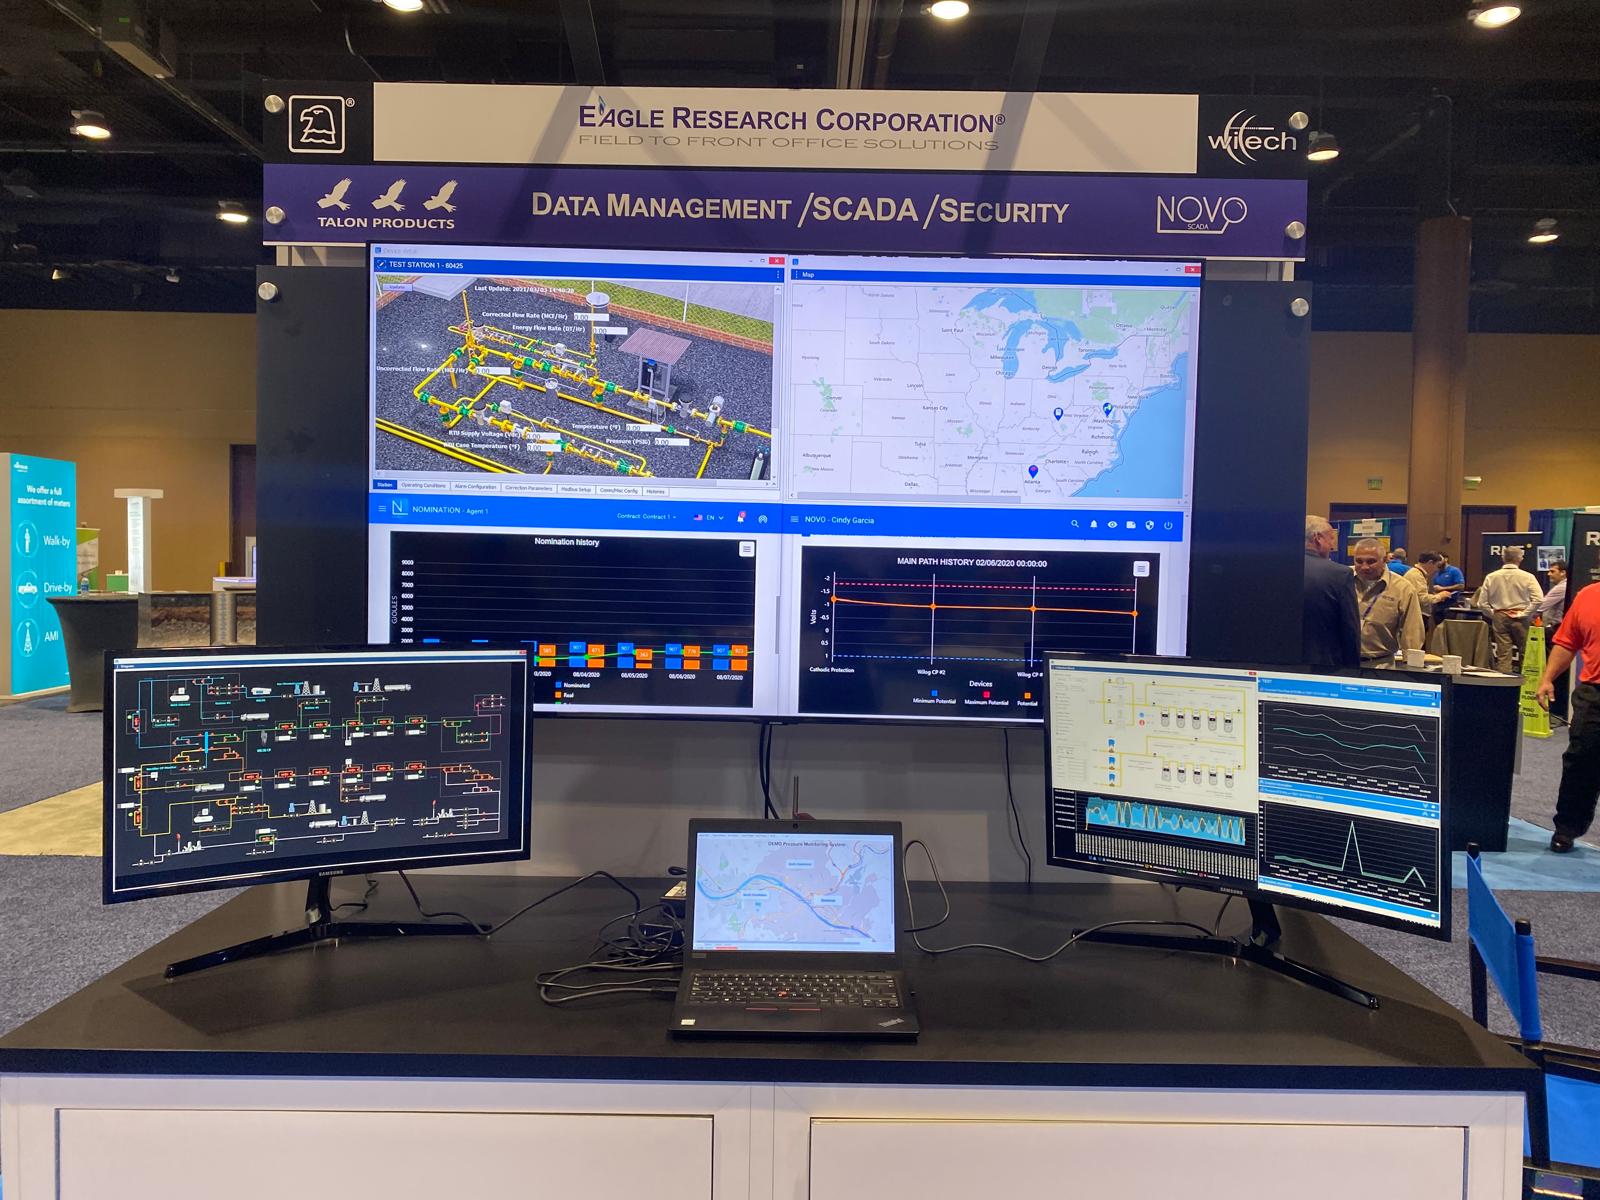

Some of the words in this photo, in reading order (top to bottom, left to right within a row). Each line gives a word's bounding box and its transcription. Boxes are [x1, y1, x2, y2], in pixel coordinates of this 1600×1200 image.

[579, 100, 664, 129] EAGLE
[672, 106, 807, 132] RESEARCH
[579, 134, 643, 146] FIELD
[648, 135, 682, 147] TO
[687, 136, 767, 148] FRONT
[772, 137, 858, 150] OFFICE
[863, 138, 1000, 152] SOLUTIONS
[531, 191, 601, 217] DATA
[606, 193, 792, 221] MANAGEMENT
[797, 193, 919, 228] /SCADA
[923, 194, 1070, 230] /SECURITY
[1157, 196, 1248, 226] NOVO
[317, 216, 368, 229] TALON
[372, 217, 456, 230] PRODUCTS
[407, 261, 435, 269] STATION
[802, 271, 815, 279] Map
[460, 430, 480, 438] Supply
[26, 484, 36, 494] We
[36, 485, 49, 495] offer
[53, 486, 62, 496] full
[17, 497, 47, 506] assortment
[47, 497, 53, 506] of
[53, 500, 71, 508] meters
[412, 506, 461, 514] NOMINATION
[466, 507, 484, 515] Agent
[831, 516, 851, 525] Cindy
[43, 535, 71, 549] Walk-by
[534, 537, 574, 546] Nomination
[575, 538, 600, 549] history
[897, 557, 917, 566] MAIN
[918, 558, 939, 566] PATH
[939, 559, 974, 567] HISTORY
[43, 582, 73, 594] Drive-by
[44, 631, 59, 642] AMI
[1017, 700, 1038, 708] Potential
[804, 841, 828, 849] Monitoring
[318, 869, 344, 877] SAMSUNG
[1220, 886, 1244, 895] SAMSUNG
